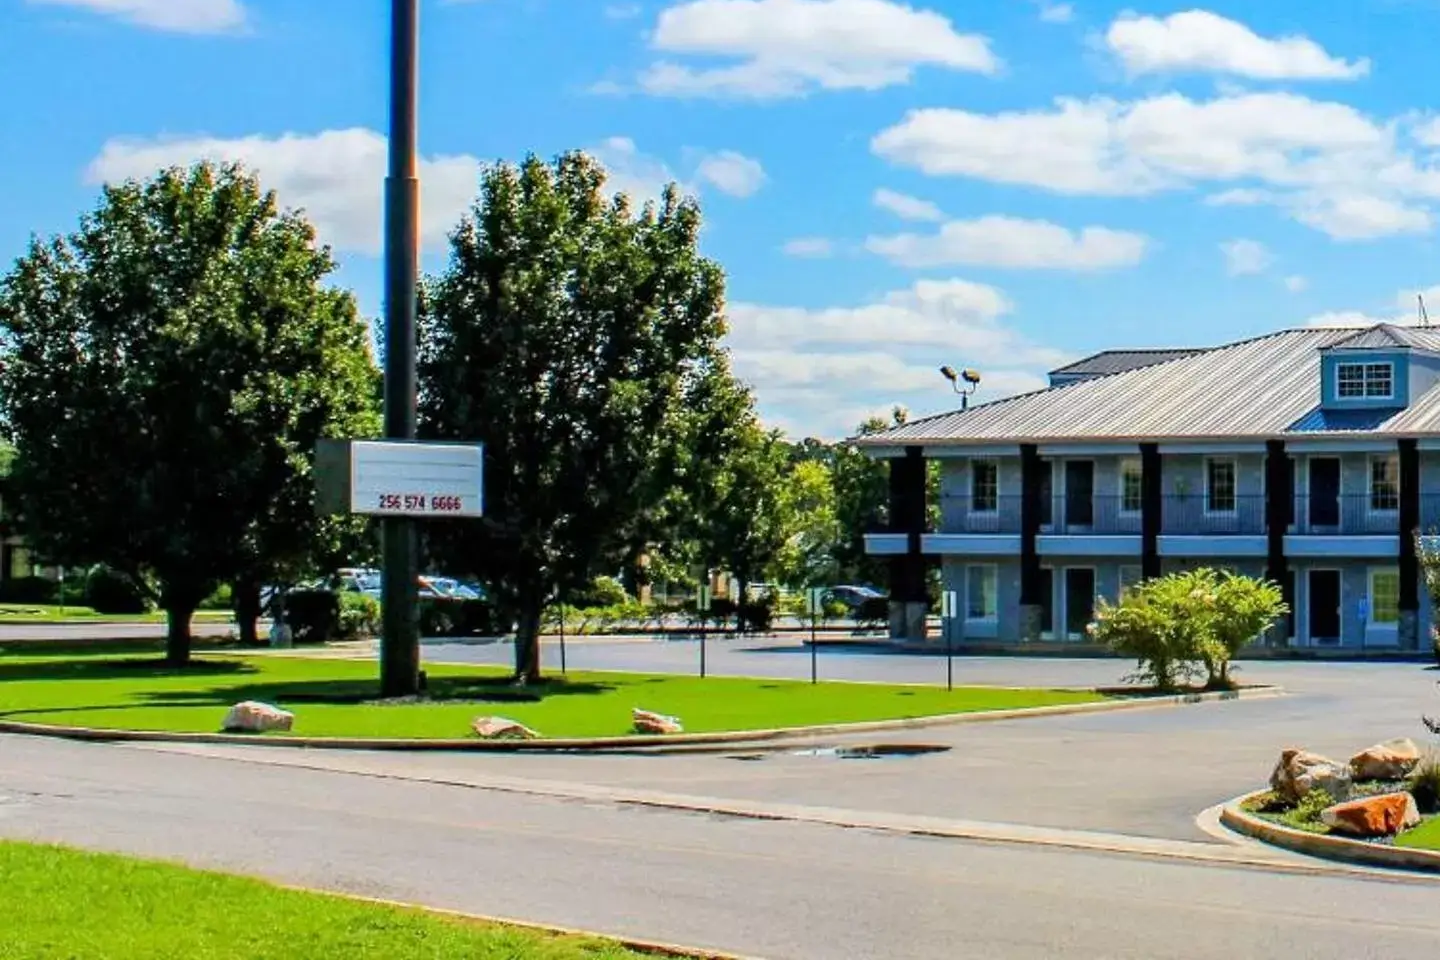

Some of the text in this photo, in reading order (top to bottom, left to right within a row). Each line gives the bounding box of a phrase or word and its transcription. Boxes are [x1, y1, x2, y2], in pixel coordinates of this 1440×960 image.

[379, 494, 462, 510] 256 574 6666
